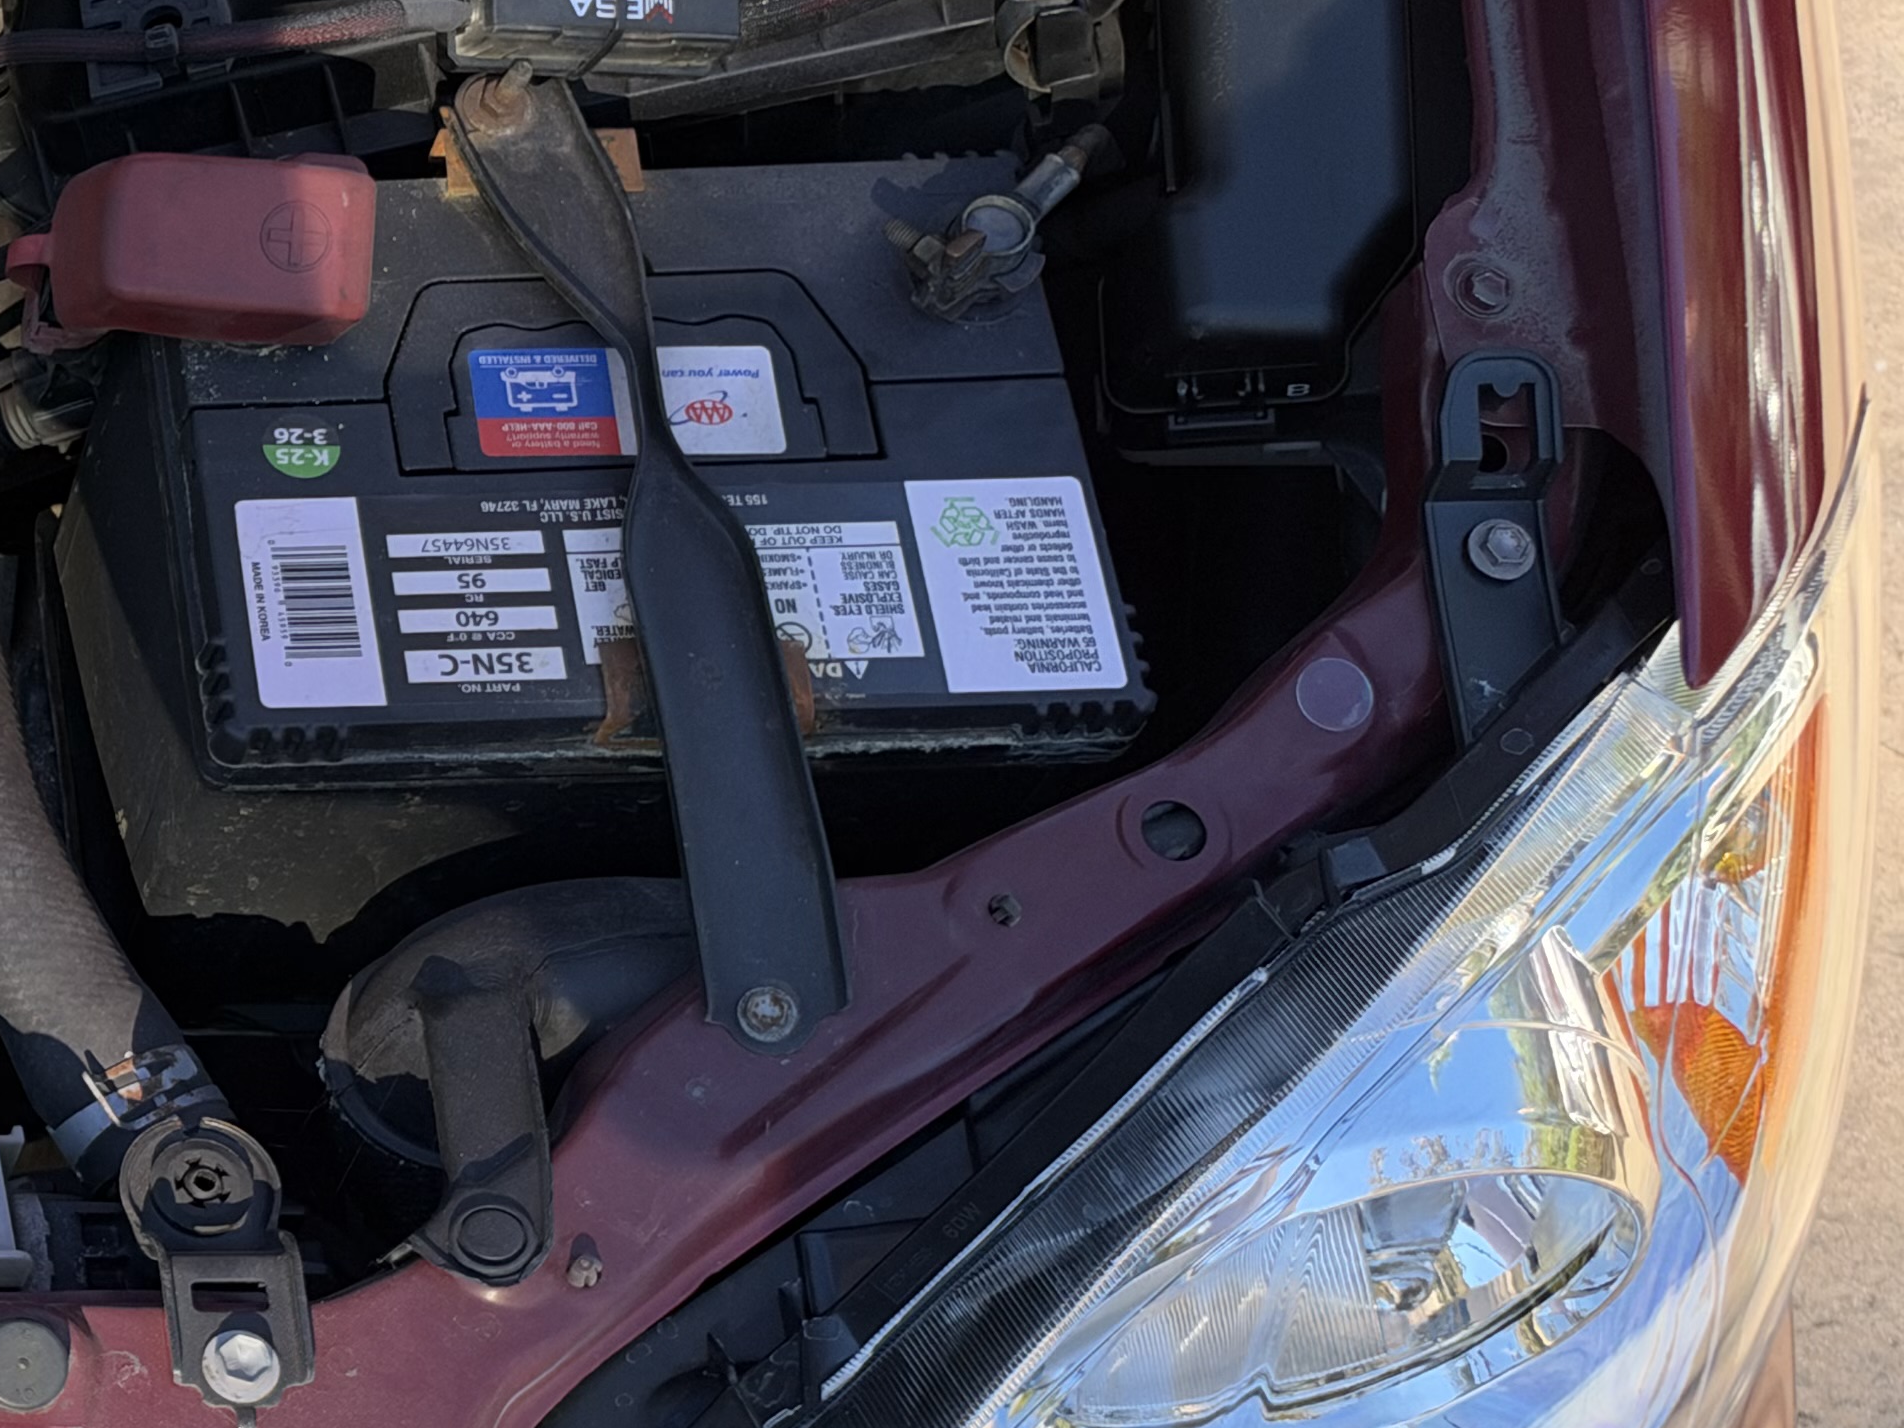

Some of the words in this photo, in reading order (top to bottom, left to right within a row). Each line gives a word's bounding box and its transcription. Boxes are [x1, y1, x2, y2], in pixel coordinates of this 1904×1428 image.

[478, 354, 531, 365] INSTALLED
[534, 355, 541, 364] &
[544, 354, 597, 364] DELIVERED
[661, 369, 684, 378] can
[688, 367, 713, 378] you
[718, 368, 760, 379] Power
[686, 401, 727, 424] AAA
[501, 422, 576, 432] 800-AAA-HELP
[578, 421, 598, 432] Call
[273, 428, 328, 444] 3-26
[506, 431, 552, 441] support?
[556, 430, 599, 440] warranty
[526, 438, 561, 449] battery
[573, 439, 600, 448] Need
[275, 447, 330, 466] K-25
[480, 500, 519, 512] 32746
[522, 500, 537, 511] FL
[540, 497, 580, 510] MARY,
[583, 496, 617, 509] LAKE
[1004, 496, 1062, 507] HANDLING.
[539, 511, 563, 522] LLC
[565, 509, 591, 521] U.S.
[994, 509, 1026, 519] AFTER
[1029, 508, 1065, 518] HANDS
[824, 525, 842, 533] DO
[1006, 520, 1037, 530] WASH
[1041, 519, 1067, 528] harm.
[773, 527, 792, 535] TIP.
[793, 526, 819, 534] NOT
[1012, 529, 1070, 541] reproductive
[421, 536, 511, 552] 35N64457
[782, 537, 806, 545] OUT
[810, 535, 843, 544] KEEP
[1000, 543, 1024, 553] other
[1027, 543, 1037, 551] or
[1039, 542, 1073, 552] defects
[444, 555, 492, 564] SERIAL
[880, 550, 892, 560] OR
[983, 556, 1000, 565] and
[1003, 555, 1034, 564] cancer
[1037, 554, 1064, 564] cause
[1066, 553, 1076, 564] to
[575, 558, 607, 569] FAST.
[840, 560, 895, 570] BLINDNESS
[958, 556, 980, 567] birth
[251, 562, 260, 584] MADE
[582, 569, 622, 580] EDICAL
[843, 571, 874, 580] CAUSE
[877, 571, 897, 579] CAN
[966, 568, 1011, 578] California
[1013, 567, 1022, 578] of
[1025, 566, 1050, 577] State
[1052, 566, 1067, 576] the
[1070, 566, 1079, 575] to
[457, 572, 486, 589] 95
[973, 579, 1004, 590] known
[1005, 578, 1054, 588] chemicals
[1057, 577, 1081, 588] other
[584, 581, 606, 592] GET
[863, 581, 899, 592] GASES
[256, 586, 264, 599] IN
[465, 593, 484, 602] RC
[840, 592, 902, 603] EXPLOSIVE
[983, 589, 1040, 601] compounds,
[1043, 591, 1063, 600] lead
[1066, 589, 1084, 599] and
[775, 598, 797, 613] NO
[830, 605, 862, 616] EYES.
[865, 603, 905, 615] SHIELD
[971, 604, 991, 613] lead
[994, 603, 1029, 612] contain
[1031, 601, 1086, 612] accessories
[257, 602, 269, 641] KOREA
[455, 610, 499, 627] 640
[989, 615, 1022, 625] related
[1024, 614, 1042, 624] and
[1045, 613, 1090, 623] terminals
[980, 624, 1008, 636] posts,
[1011, 622, 1044, 636] battery
[1048, 624, 1093, 635] Batteries,
[486, 631, 515, 640] CCA
[1013, 637, 1079, 649] WARNING:
[1082, 636, 1096, 648] 65
[1014, 649, 1099, 662] PROPOSITION
[438, 652, 534, 676] 35N-C
[1027, 660, 1102, 673] CALIFORNIA
[457, 683, 482, 693] NO.
[484, 682, 520, 692] PART
